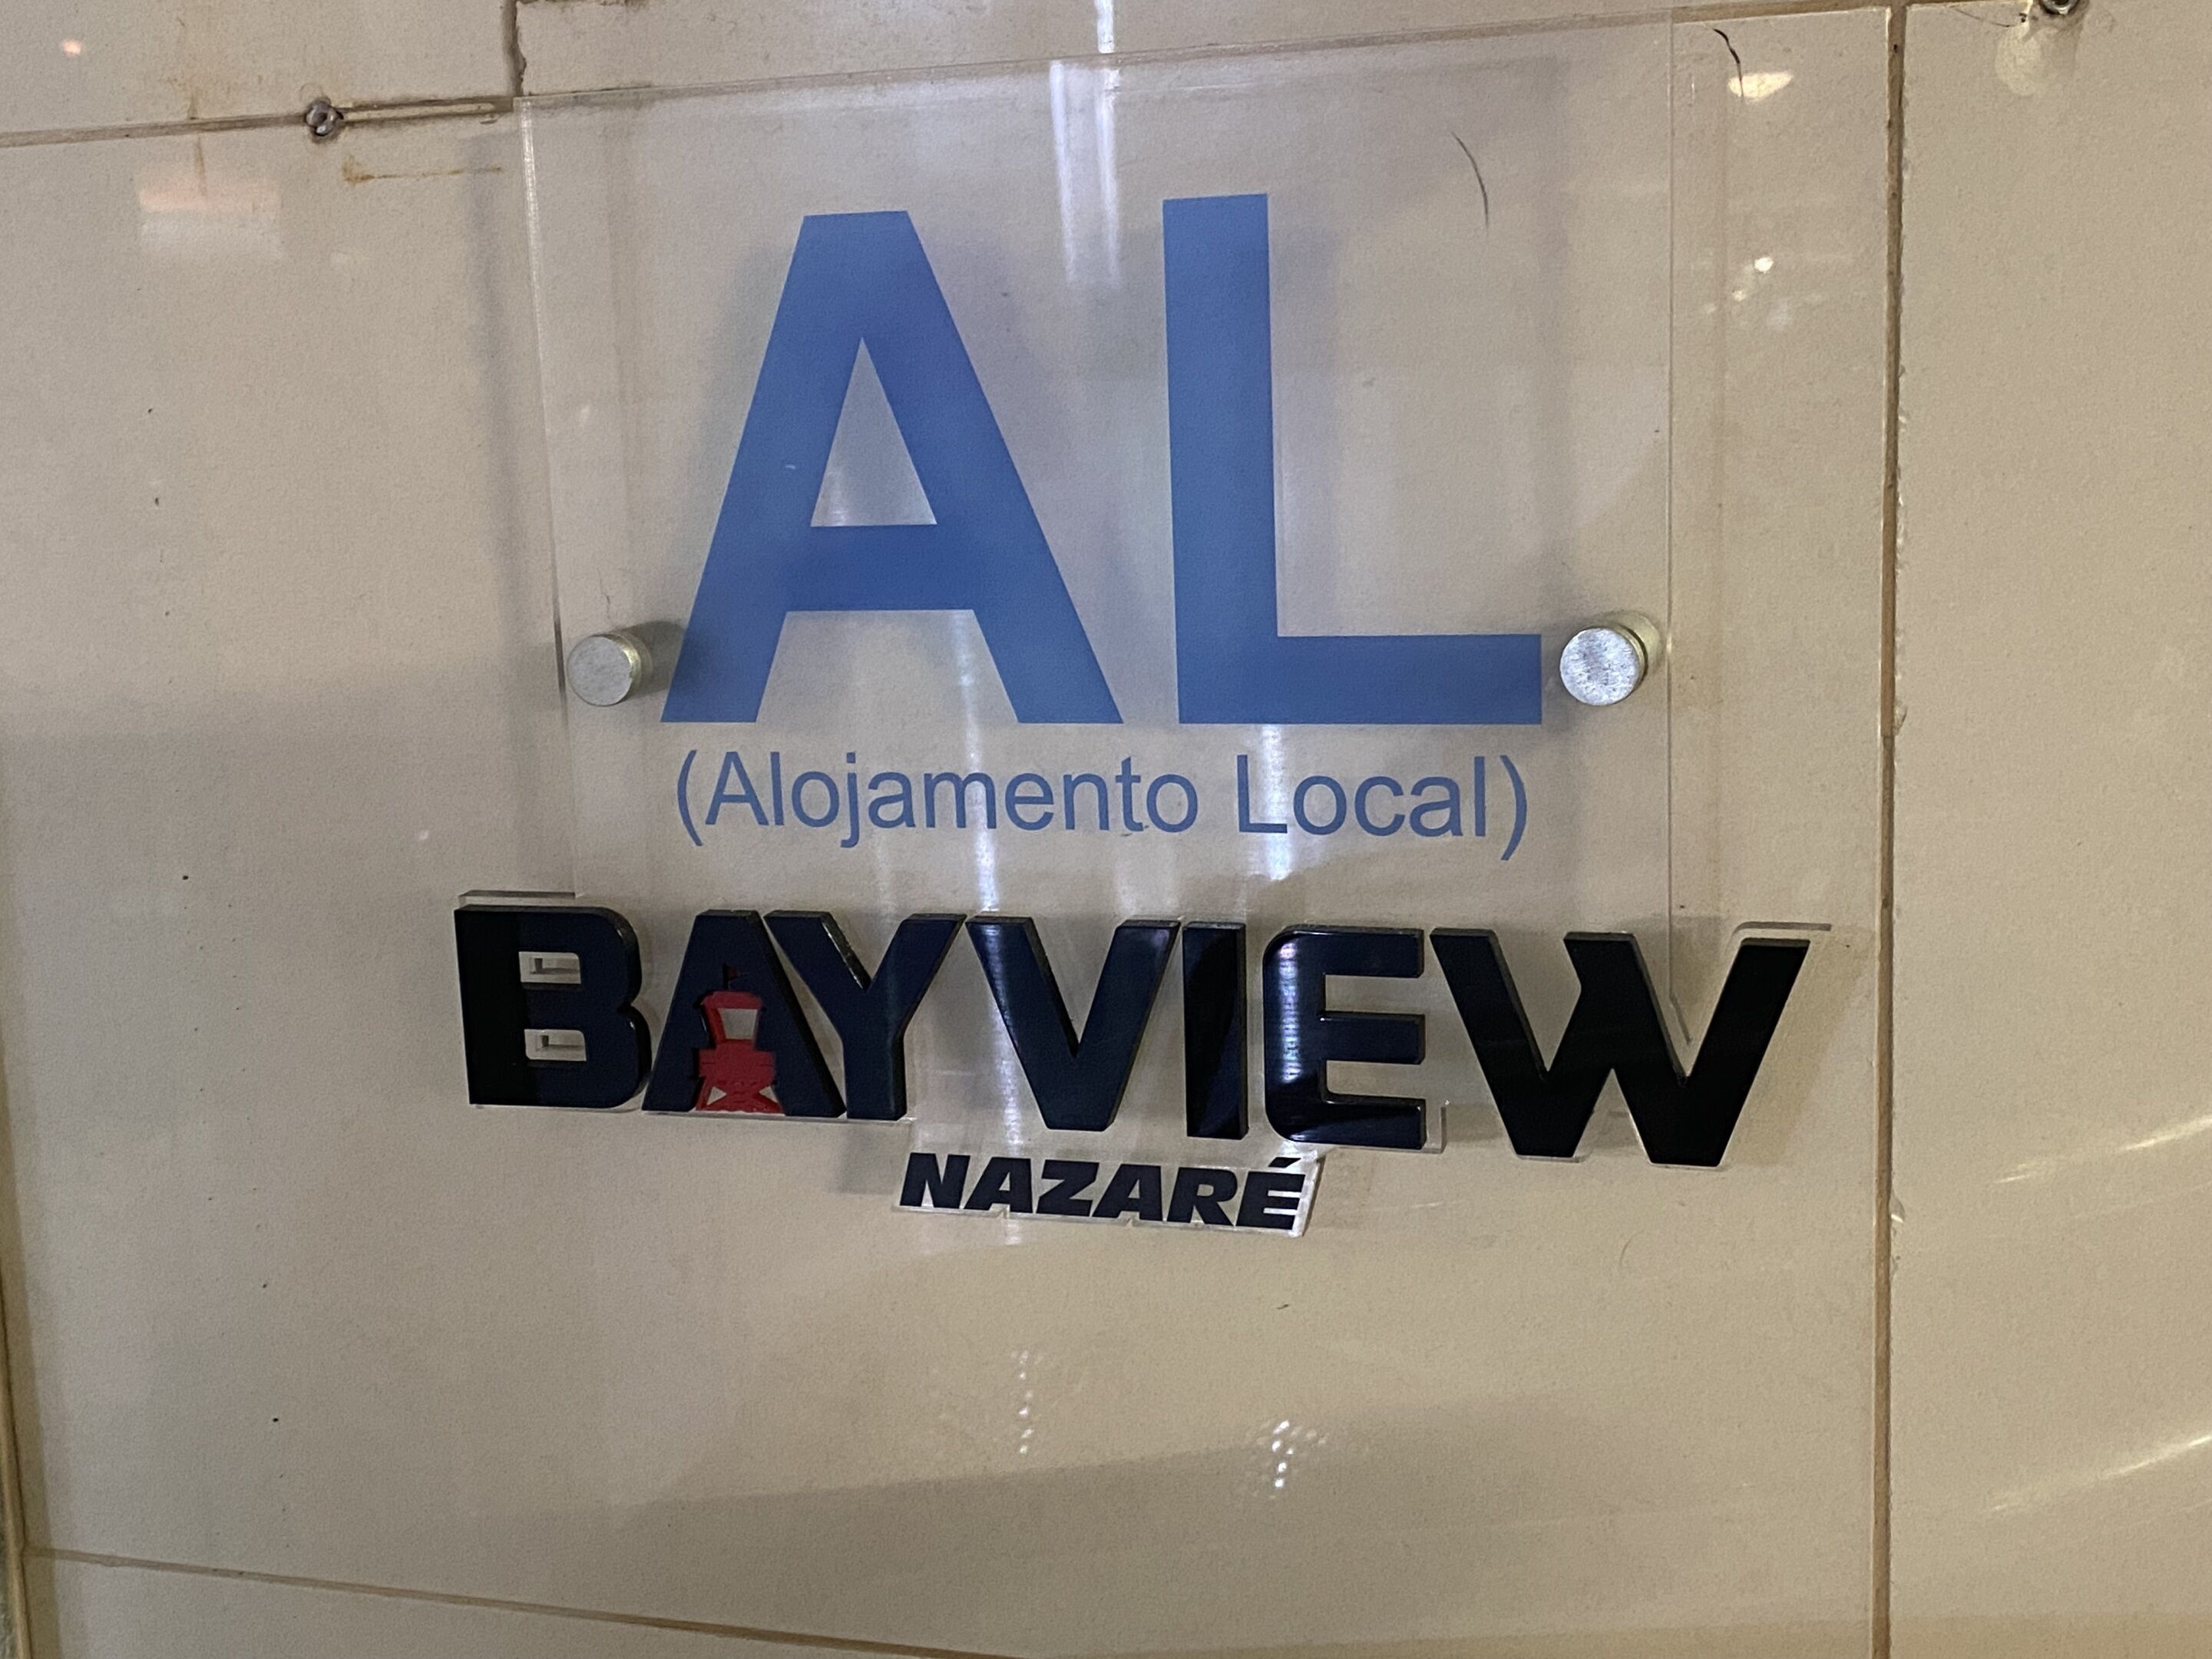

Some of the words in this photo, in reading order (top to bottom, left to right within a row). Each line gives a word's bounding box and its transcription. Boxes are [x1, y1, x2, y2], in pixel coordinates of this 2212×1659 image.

[661, 193, 1542, 723] AL
[677, 749, 1199, 848] (Alojamento
[1238, 754, 1529, 861] Local)
[455, 907, 1810, 1168] BAYVIEW
[900, 1153, 1307, 1230] NAZARÉ
